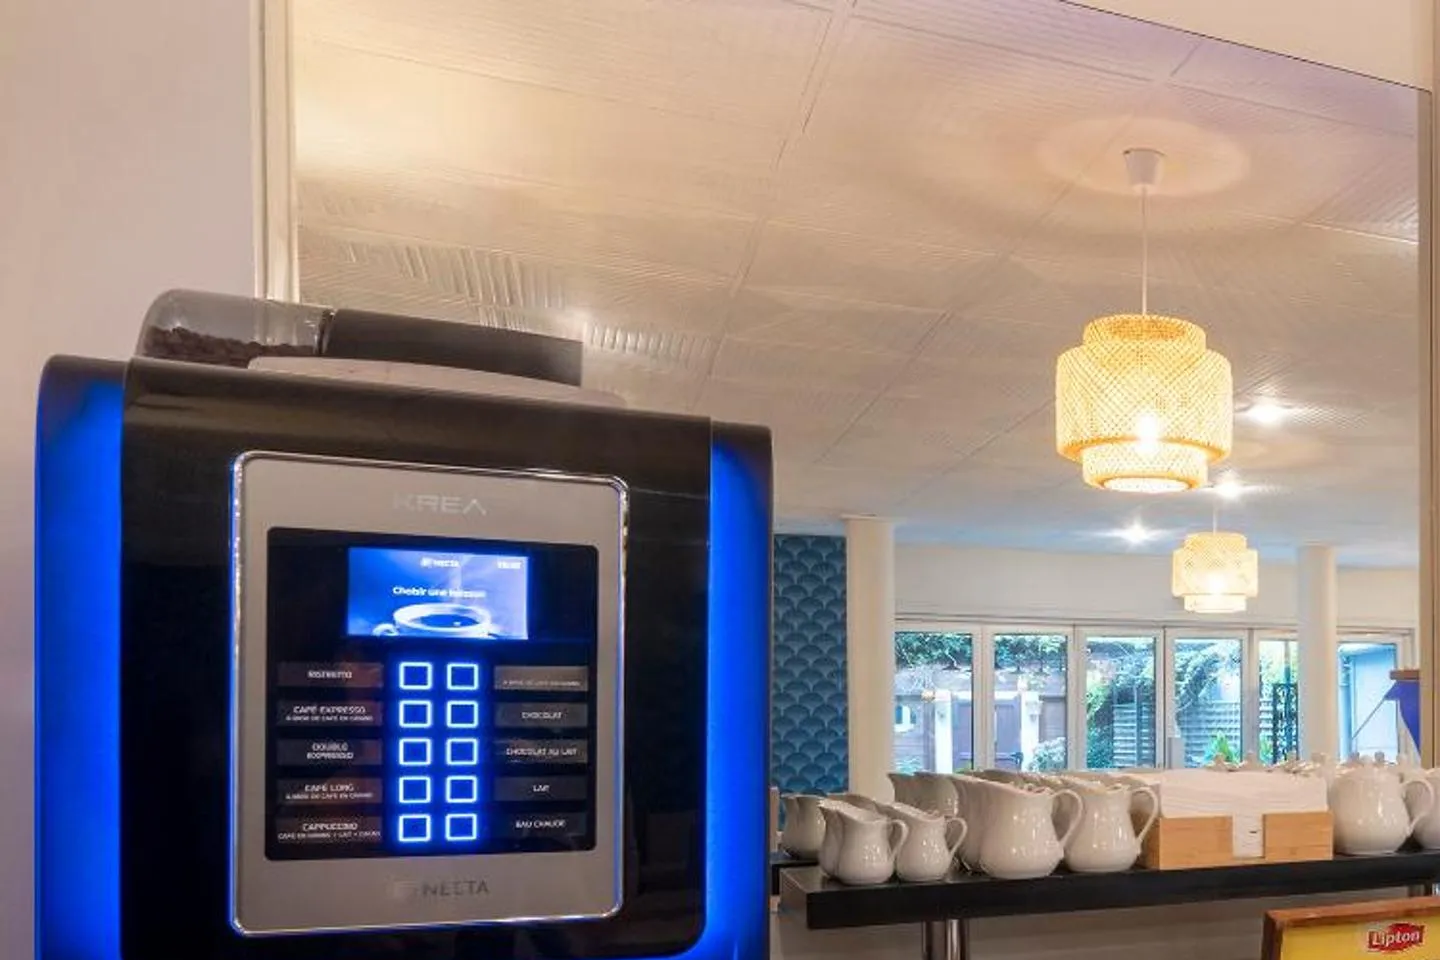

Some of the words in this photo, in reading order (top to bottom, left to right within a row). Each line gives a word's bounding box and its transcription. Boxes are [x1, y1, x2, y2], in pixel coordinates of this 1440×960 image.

[392, 490, 488, 517] KREA
[330, 783, 355, 792] LONG
[421, 879, 491, 897] NECTA
[1371, 928, 1421, 949] Lipton
